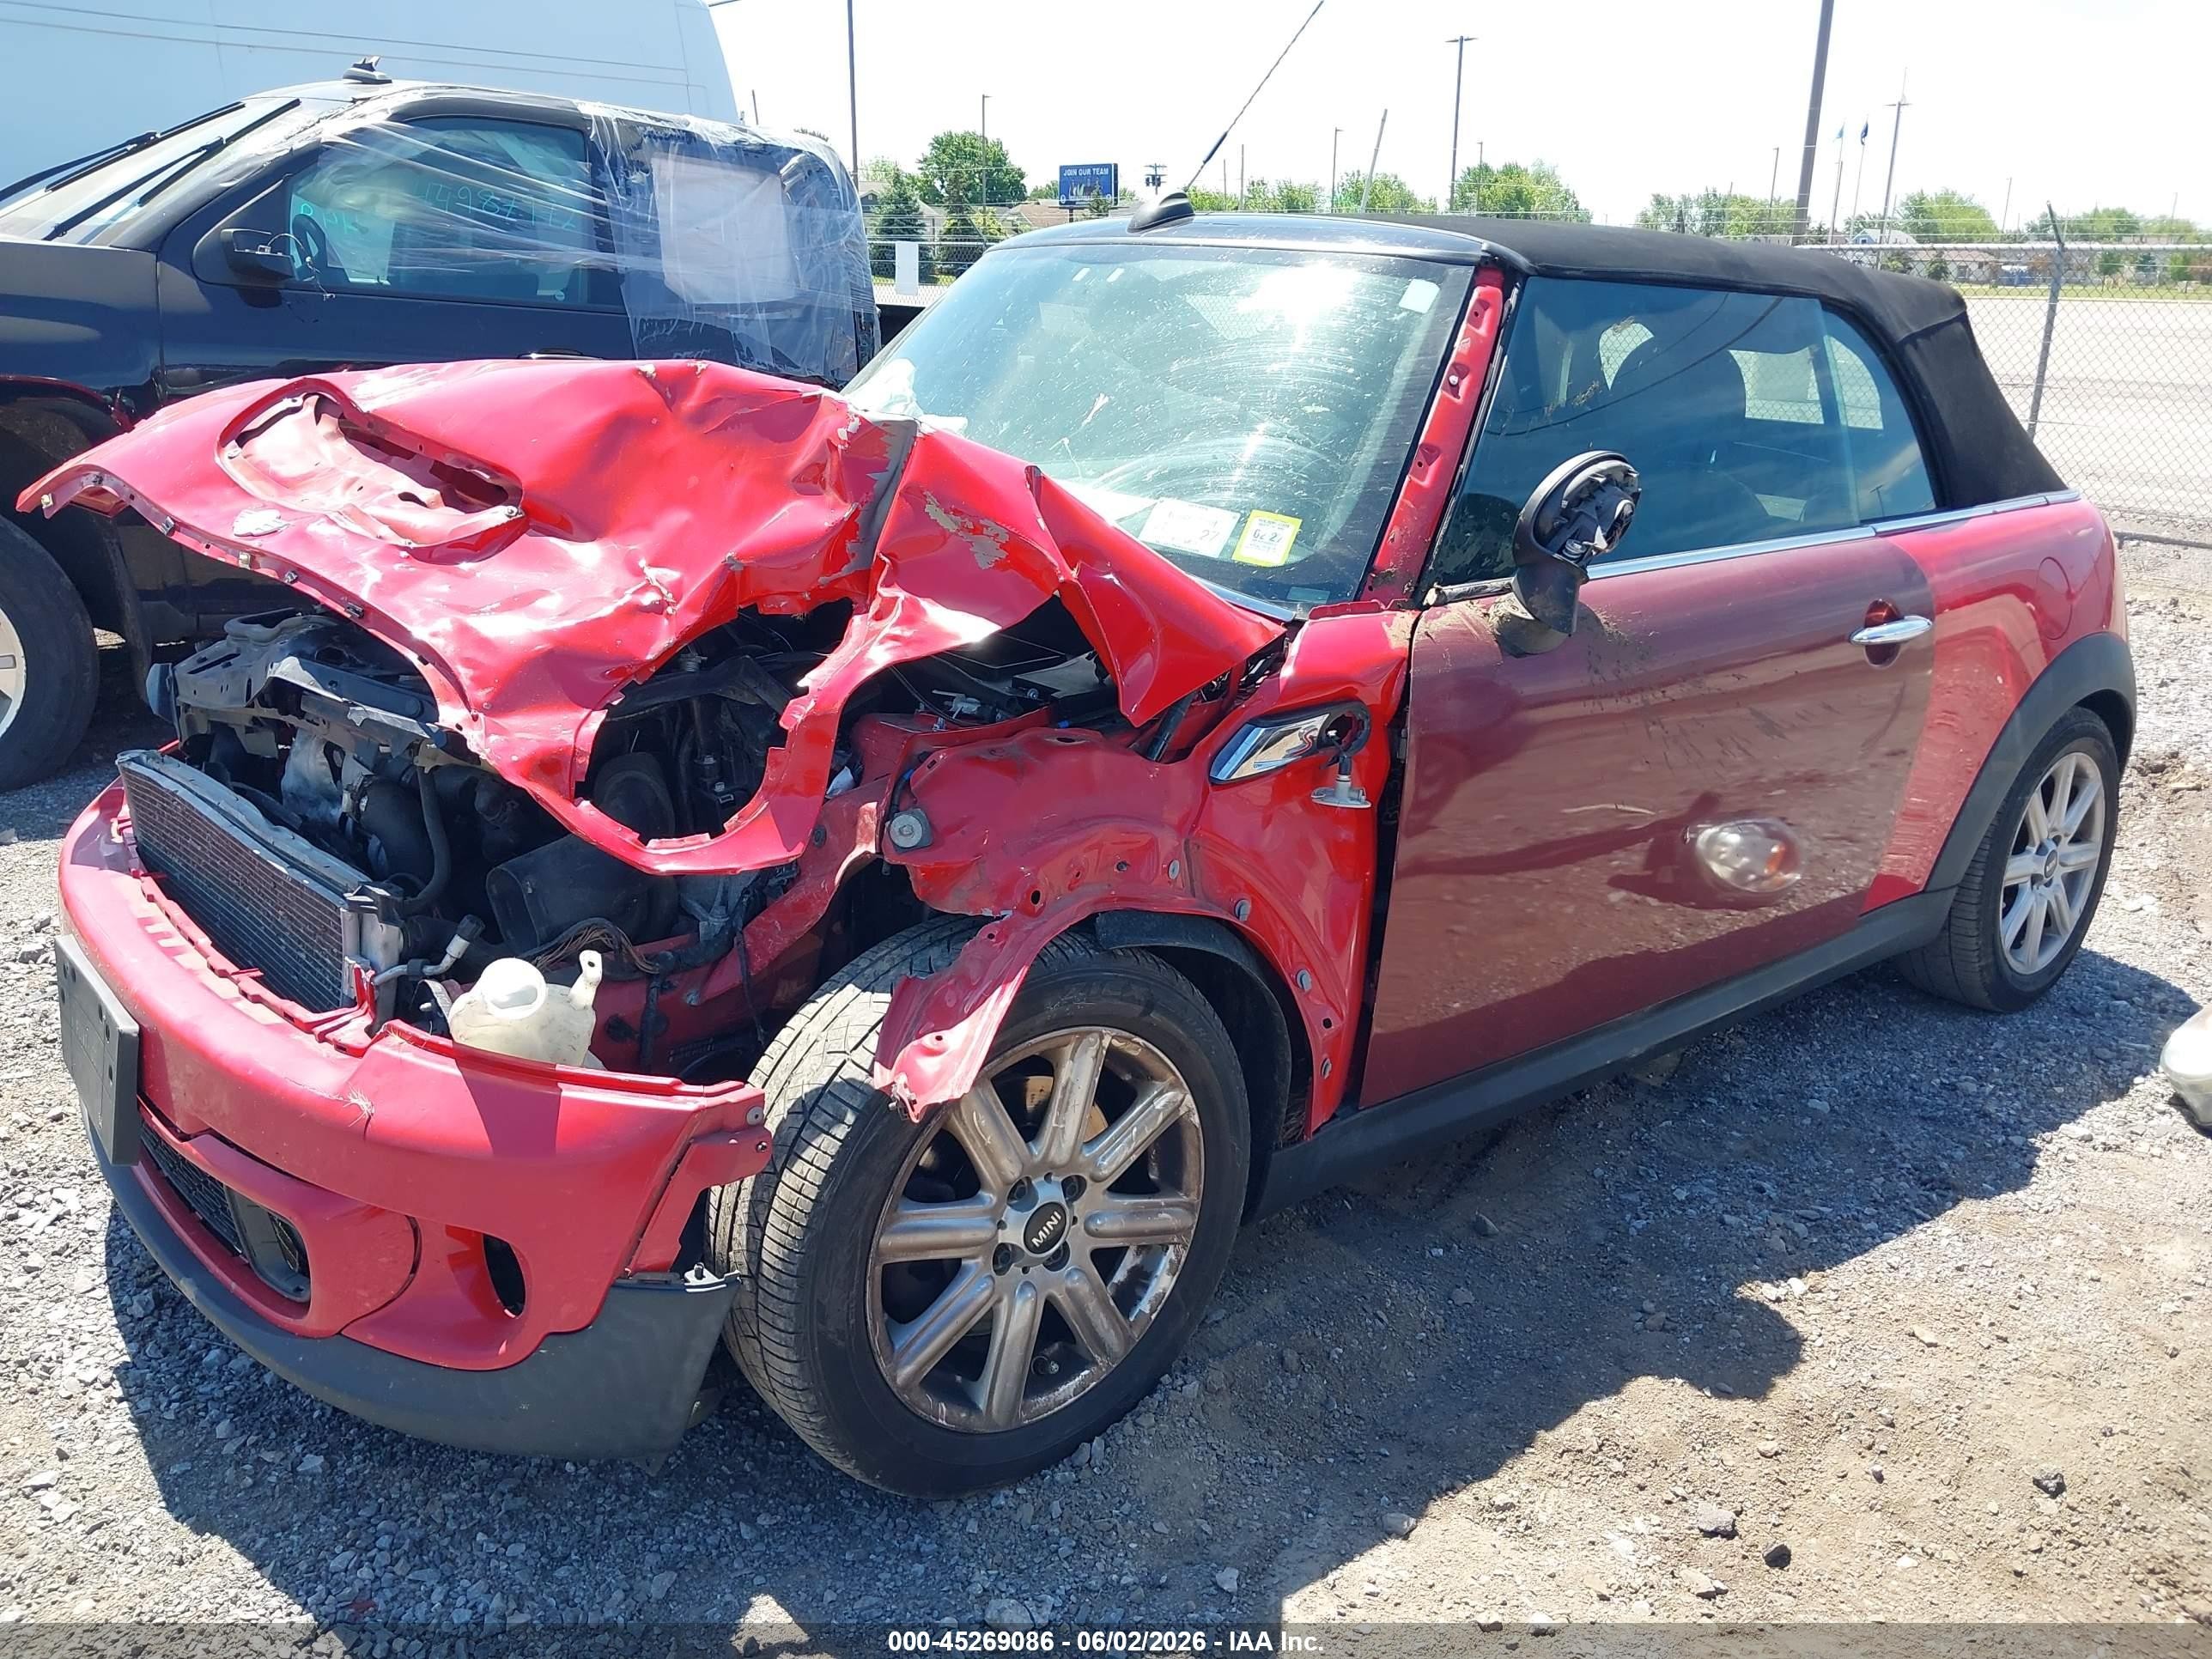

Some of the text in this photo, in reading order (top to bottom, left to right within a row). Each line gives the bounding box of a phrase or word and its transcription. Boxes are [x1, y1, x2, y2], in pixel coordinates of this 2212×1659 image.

[1063, 167, 1109, 177] JOIN OUR TEAM
[1031, 1211, 1062, 1248] MINI
